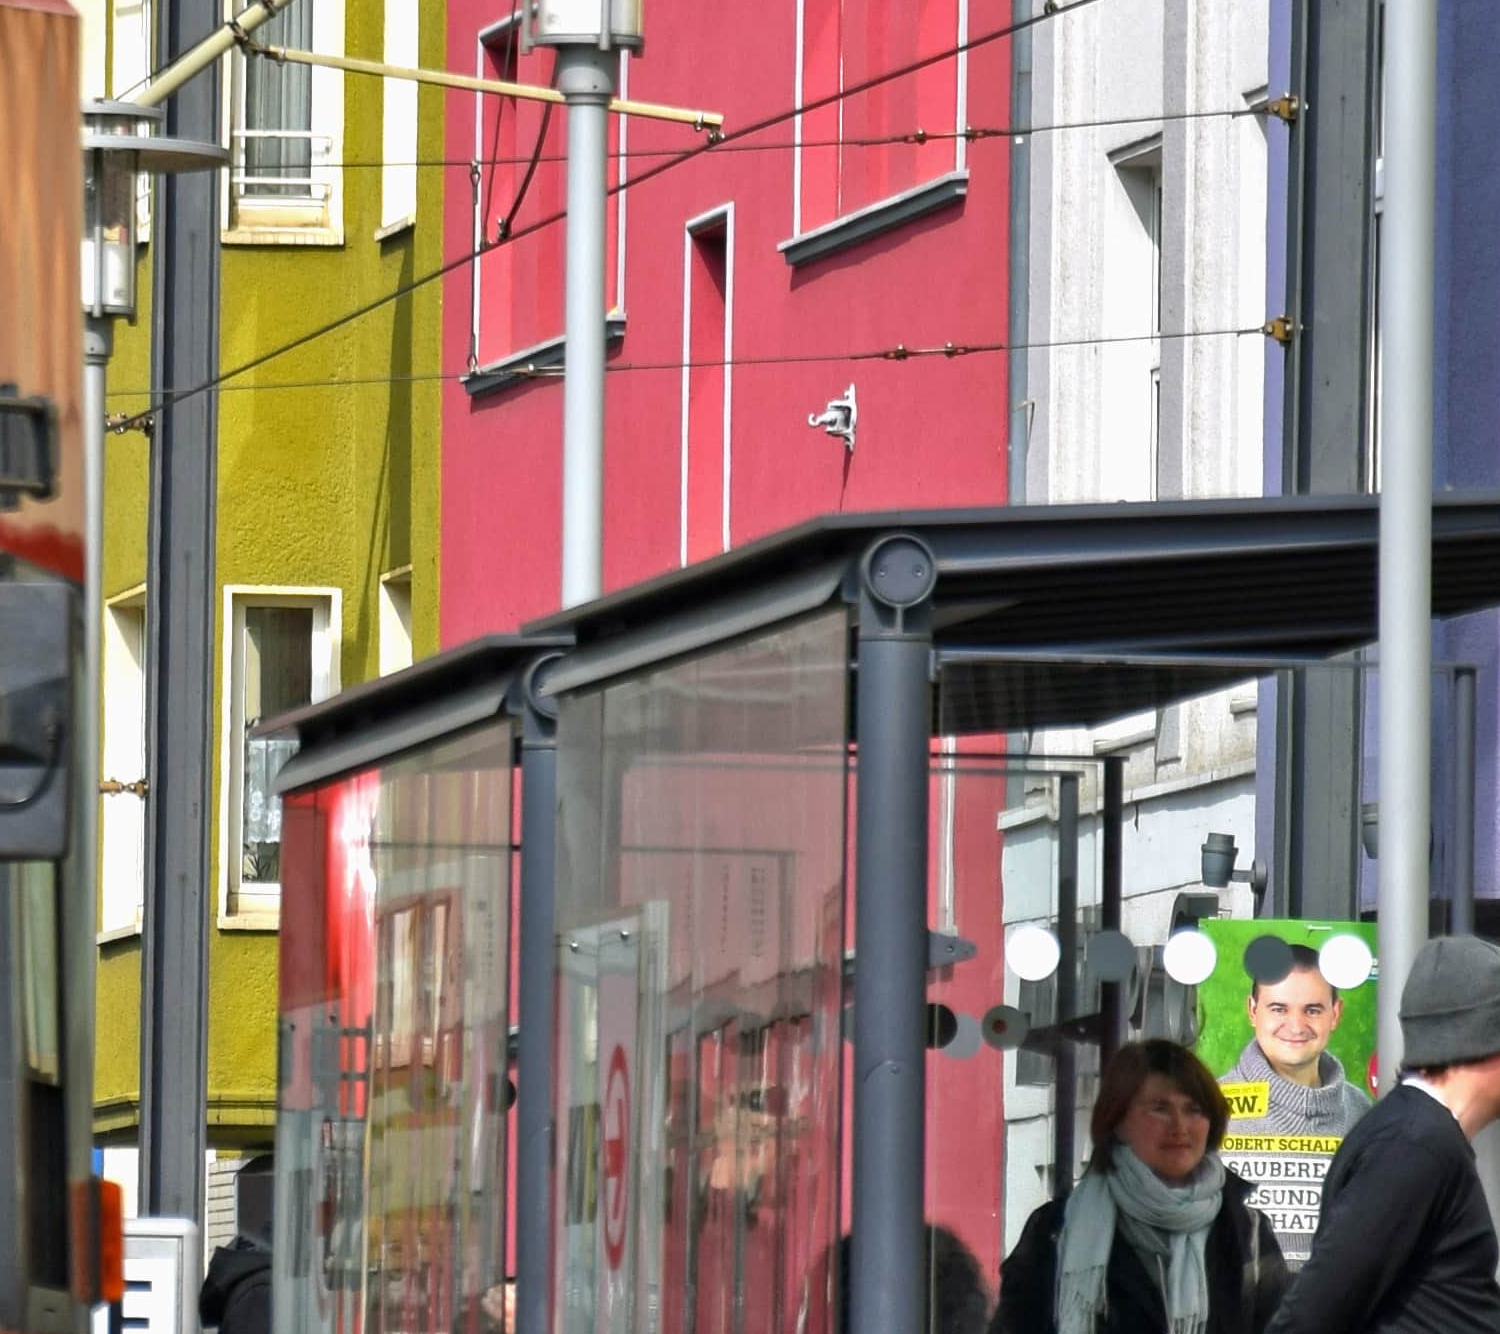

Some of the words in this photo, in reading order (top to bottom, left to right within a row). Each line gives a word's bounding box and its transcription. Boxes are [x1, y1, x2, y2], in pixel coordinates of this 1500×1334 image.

[1224, 1094, 1262, 1115] RW.
[1220, 1137, 1275, 1151] OBERT
[1278, 1138, 1341, 1152] SCHAL
[1228, 1161, 1326, 1179] SAUBERE
